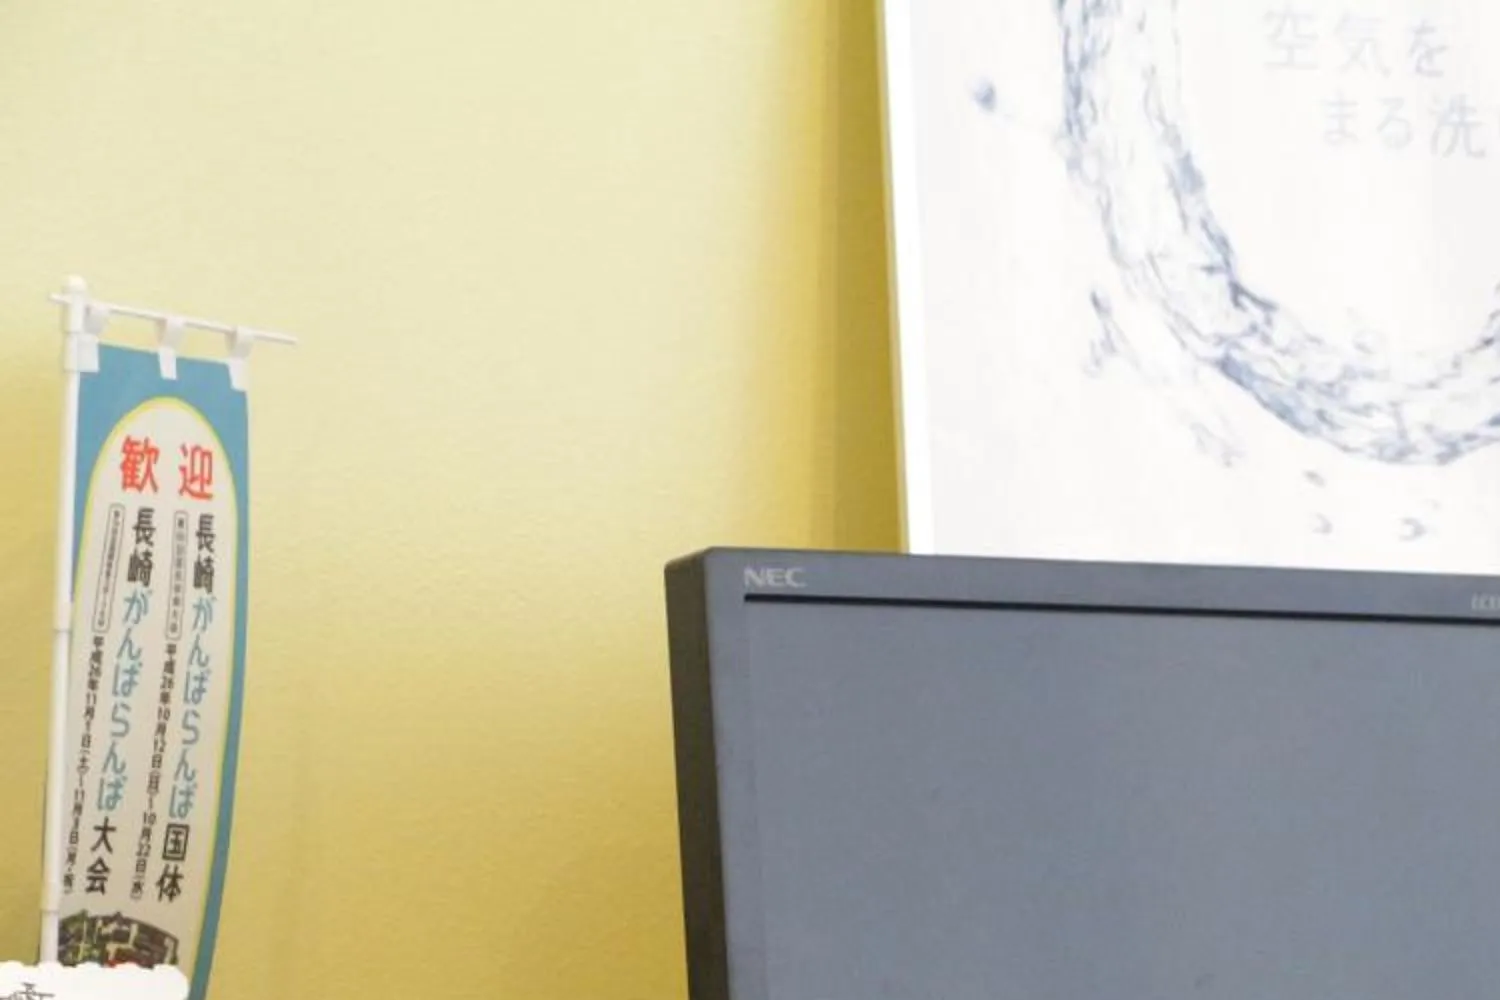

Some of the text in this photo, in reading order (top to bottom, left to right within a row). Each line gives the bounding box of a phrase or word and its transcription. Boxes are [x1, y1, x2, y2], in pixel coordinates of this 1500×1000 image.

[1262, 4, 1451, 78] 空気を
[744, 567, 807, 588] NEC
